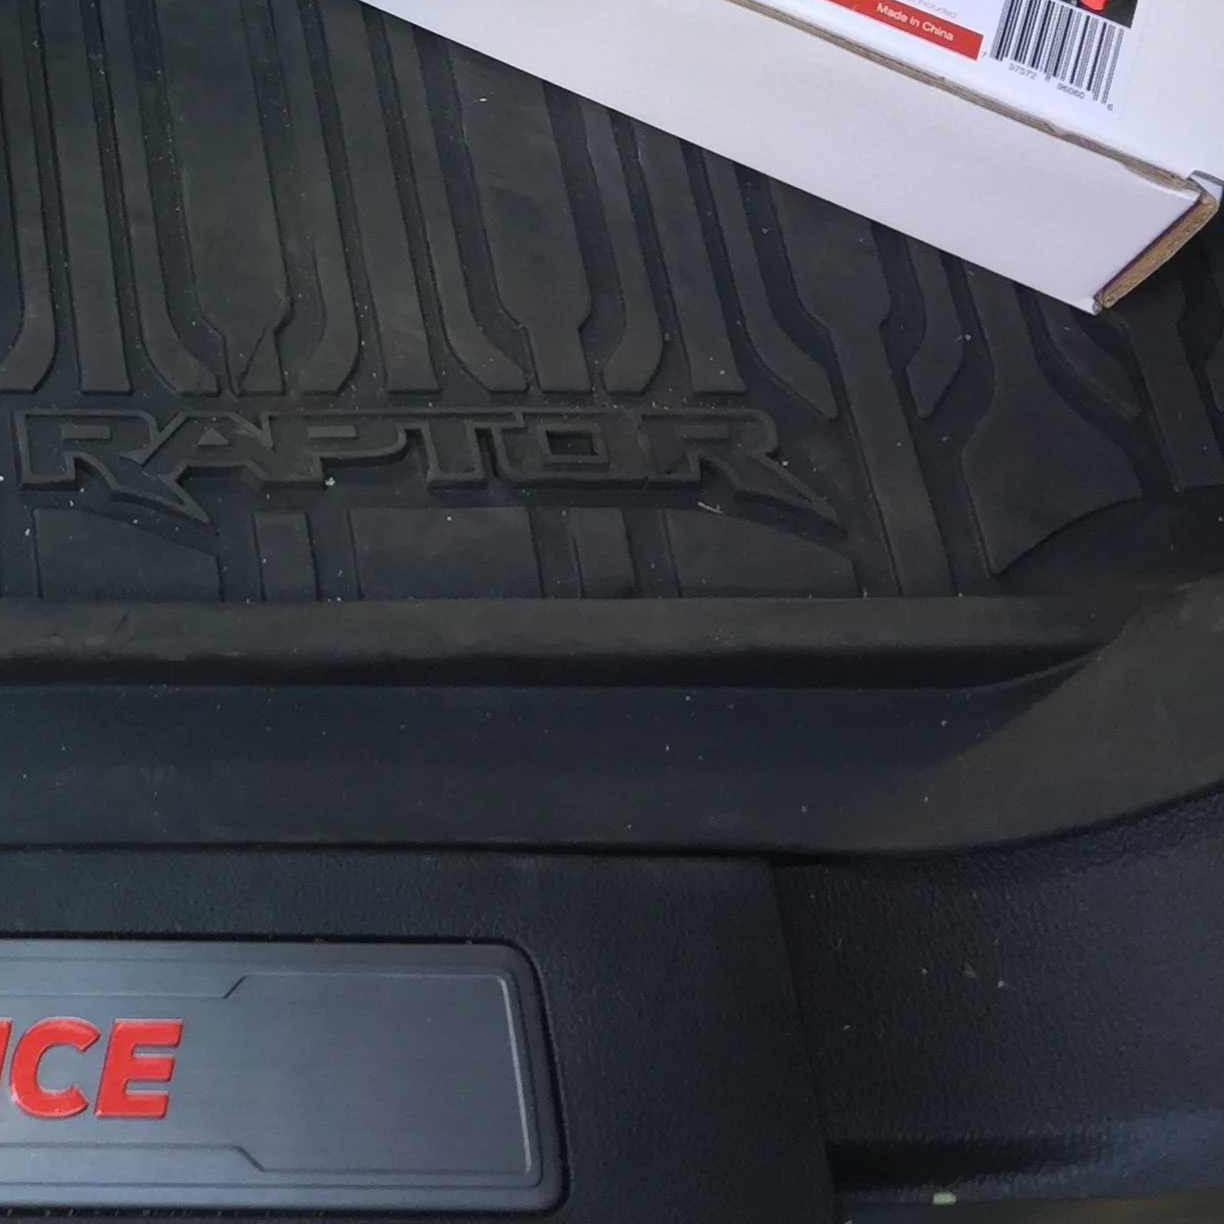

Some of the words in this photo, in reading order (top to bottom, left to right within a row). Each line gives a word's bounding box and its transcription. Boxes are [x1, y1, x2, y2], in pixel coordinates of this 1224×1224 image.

[876, 2, 909, 23] Made
[909, 15, 921, 28] in
[921, 20, 954, 42] China
[14, 408, 844, 533] RAPTOR
